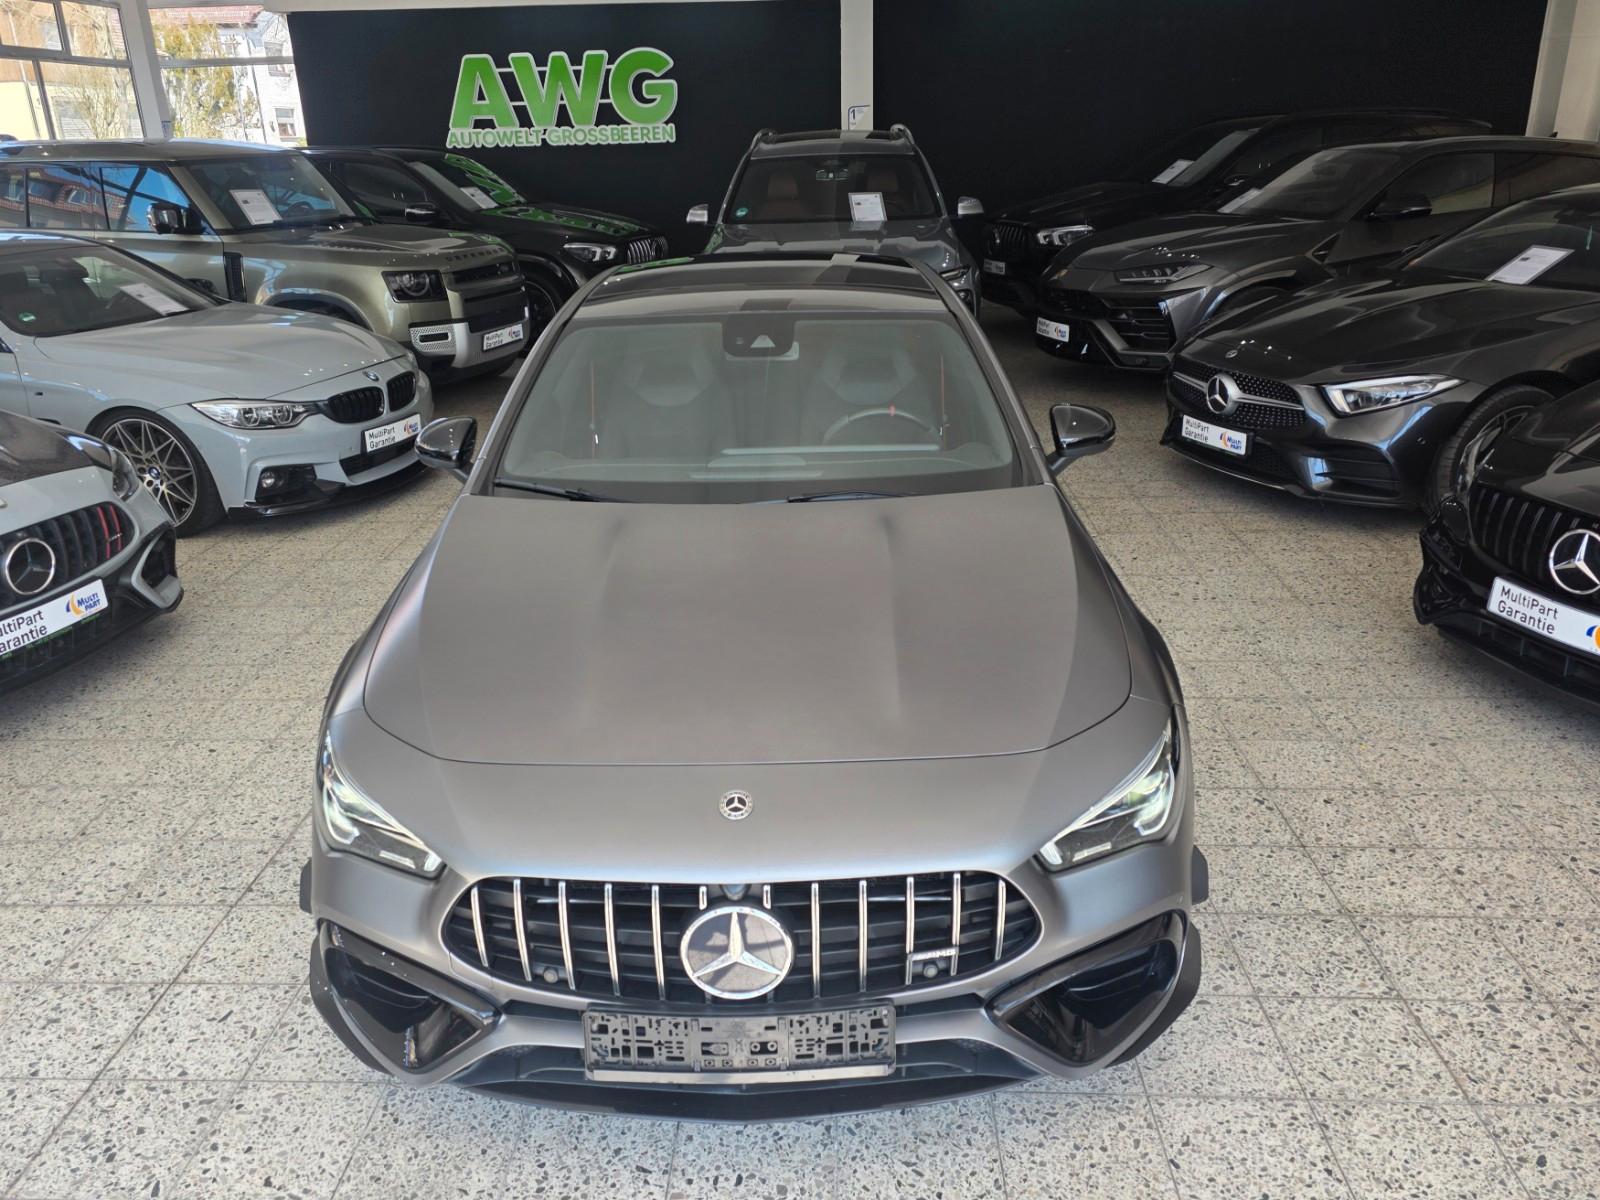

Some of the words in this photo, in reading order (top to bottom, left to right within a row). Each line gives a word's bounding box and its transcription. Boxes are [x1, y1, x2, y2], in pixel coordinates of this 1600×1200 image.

[449, 47, 678, 129] AWG
[447, 128, 542, 148] AUTOWELT
[546, 124, 676, 146] GROSSBEEREN
[368, 426, 396, 440] MultiPart
[1184, 426, 1209, 443] Garantie
[1185, 418, 1210, 432] MultiPart
[369, 435, 397, 449] Garantie
[1500, 585, 1559, 620] MultiPart
[1497, 600, 1556, 635] Garantie
[0, 624, 48, 653] arantie
